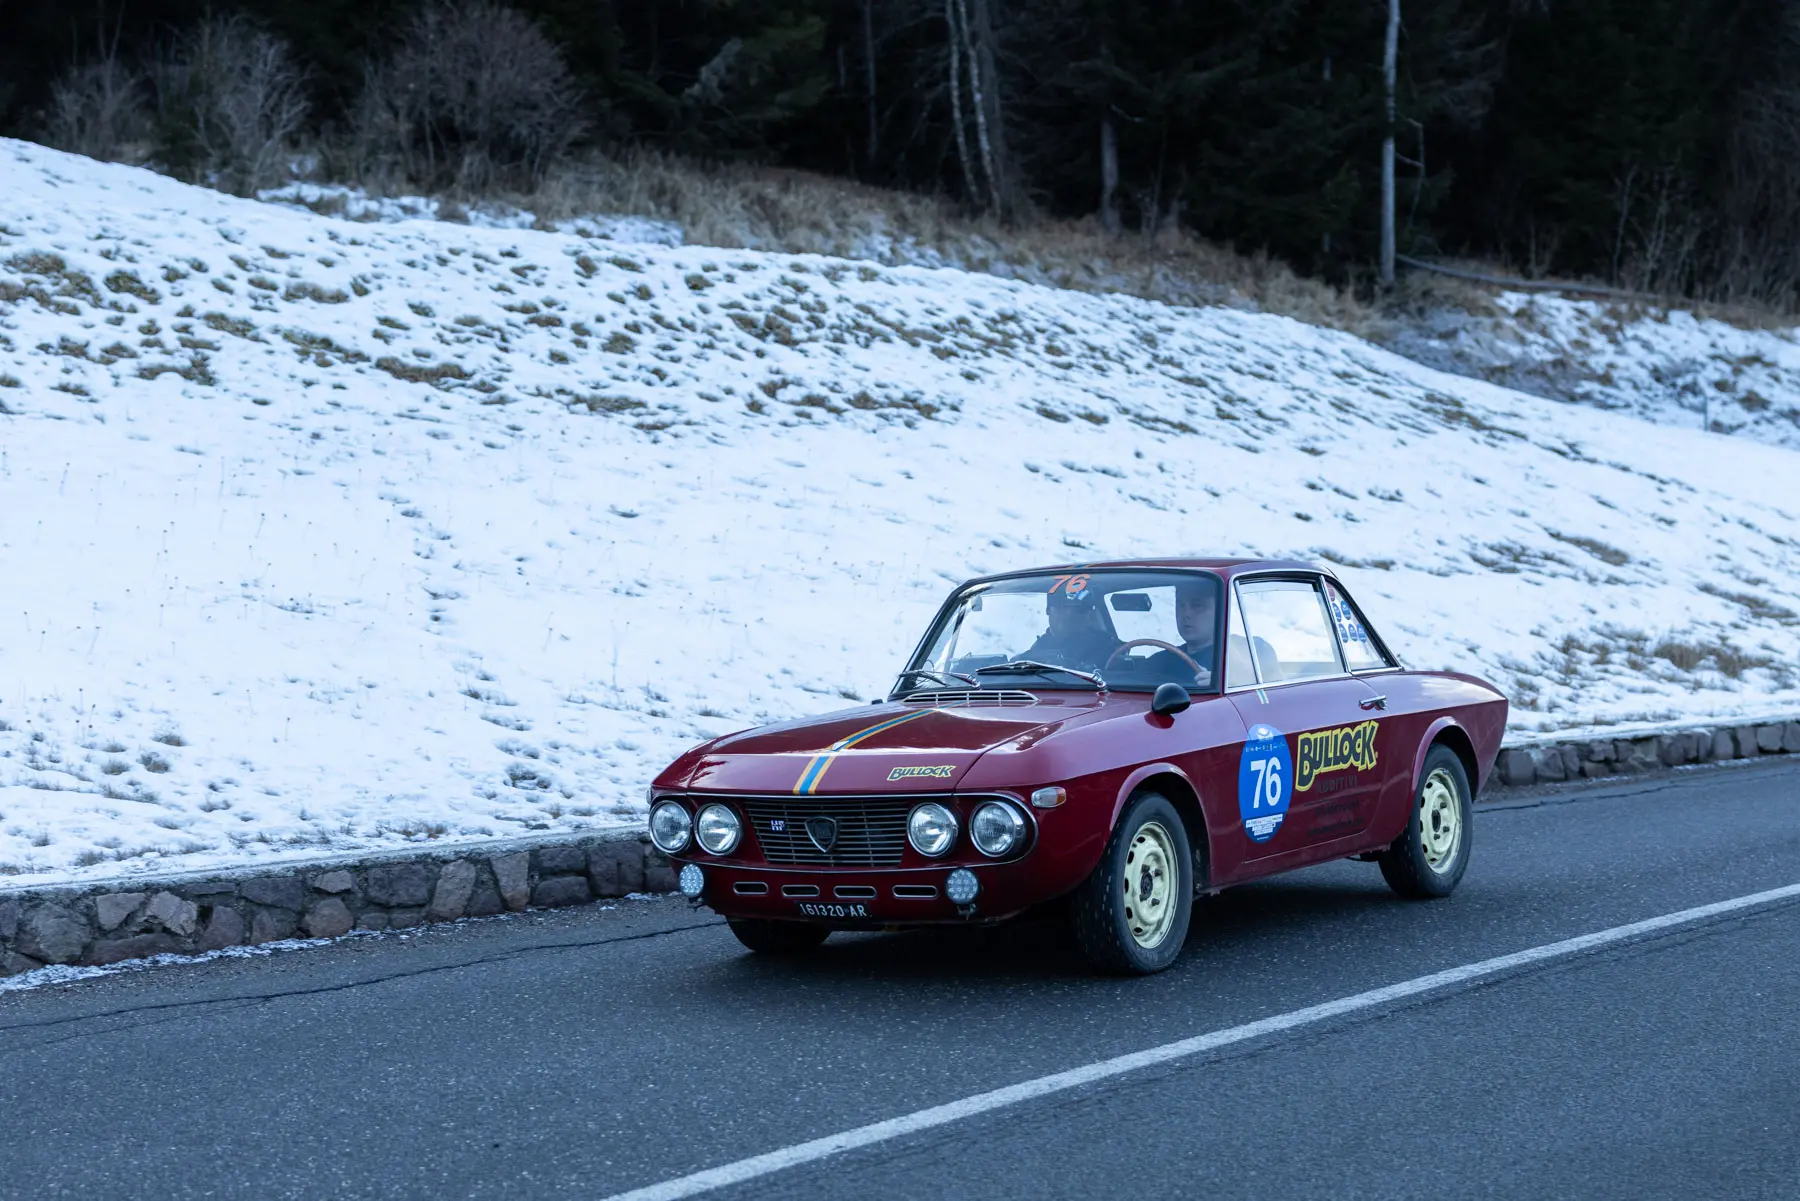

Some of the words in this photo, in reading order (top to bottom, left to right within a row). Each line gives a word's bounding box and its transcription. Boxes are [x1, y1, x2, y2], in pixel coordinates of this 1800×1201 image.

[1048, 574, 1090, 594] 76
[1296, 720, 1379, 792] BULLOCK
[887, 765, 956, 782] BULLOCK
[1250, 757, 1282, 809] 76
[800, 904, 845, 917] 161320
[849, 905, 867, 917] AR
